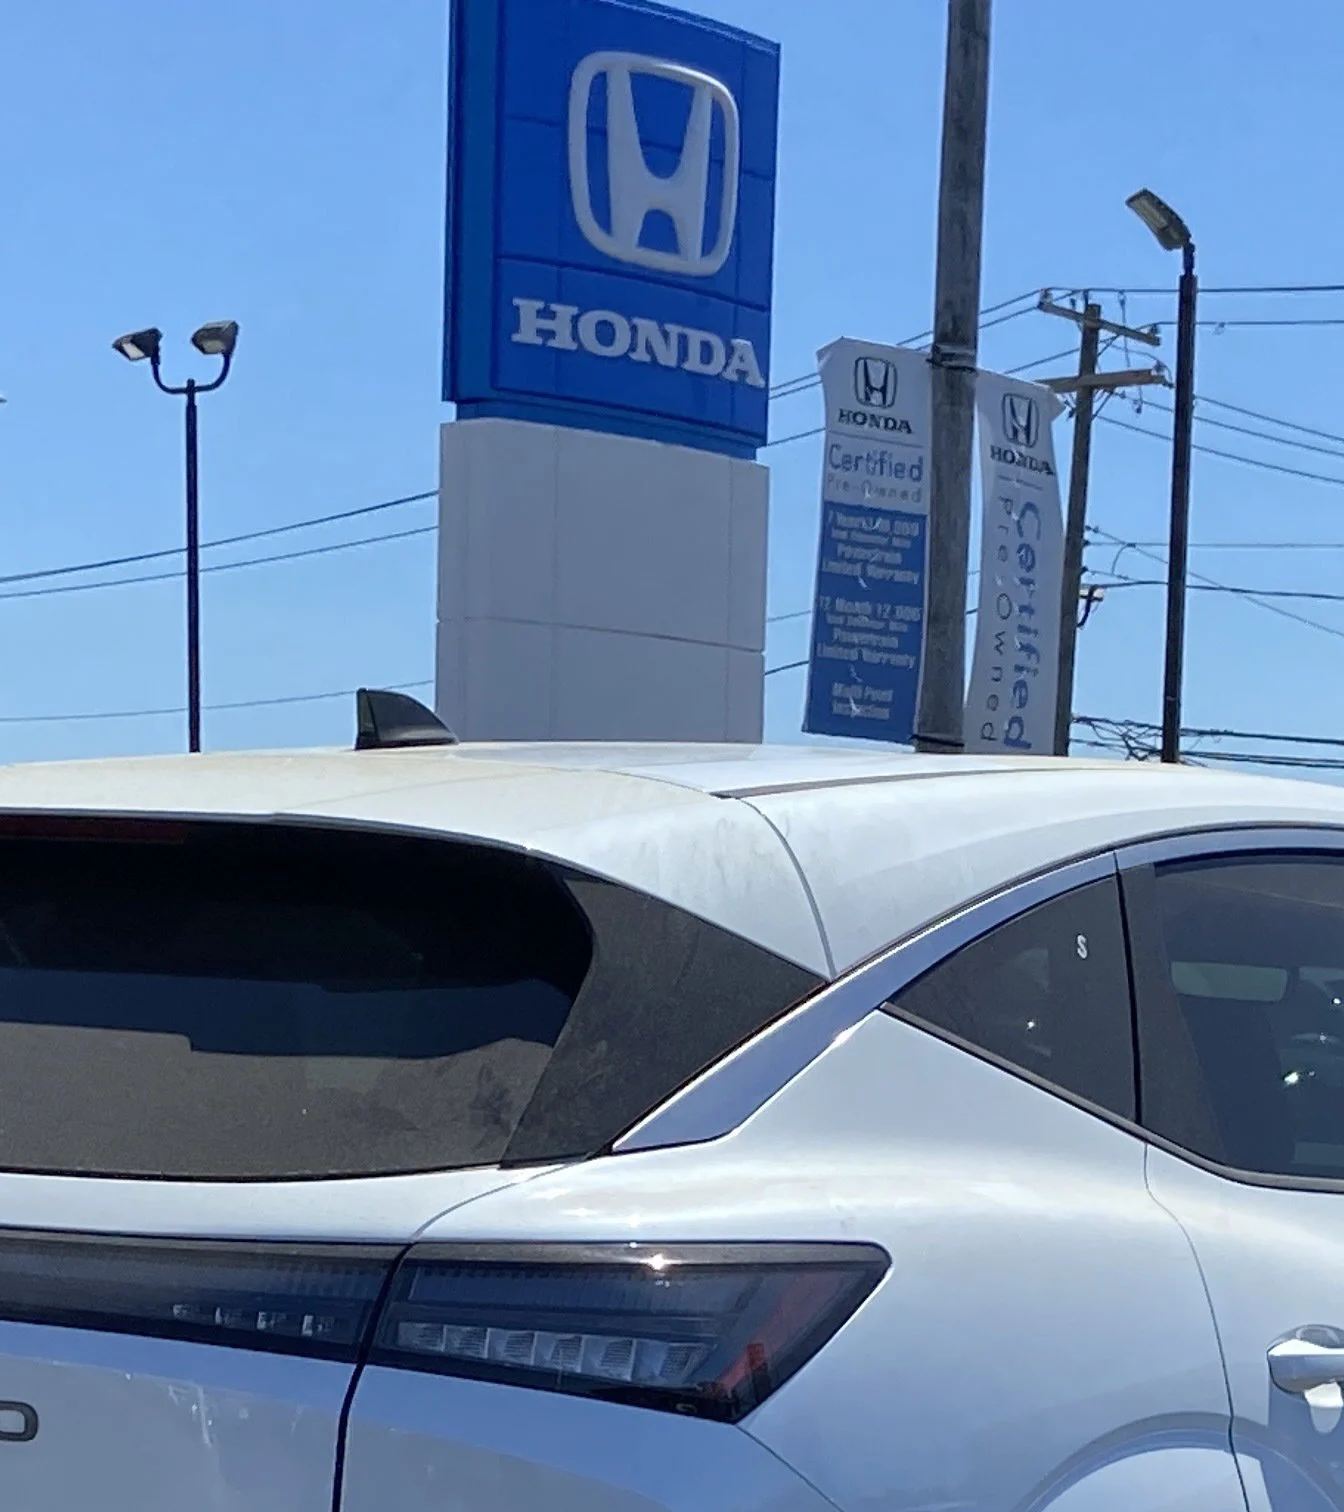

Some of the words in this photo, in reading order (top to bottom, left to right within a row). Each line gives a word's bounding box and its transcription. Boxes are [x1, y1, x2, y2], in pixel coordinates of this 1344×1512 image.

[511, 297, 766, 389] HONDA
[838, 407, 913, 434] HONDA
[828, 443, 924, 482] Certified
[989, 444, 1055, 476] HONDA
[1004, 500, 1042, 750] Certified
